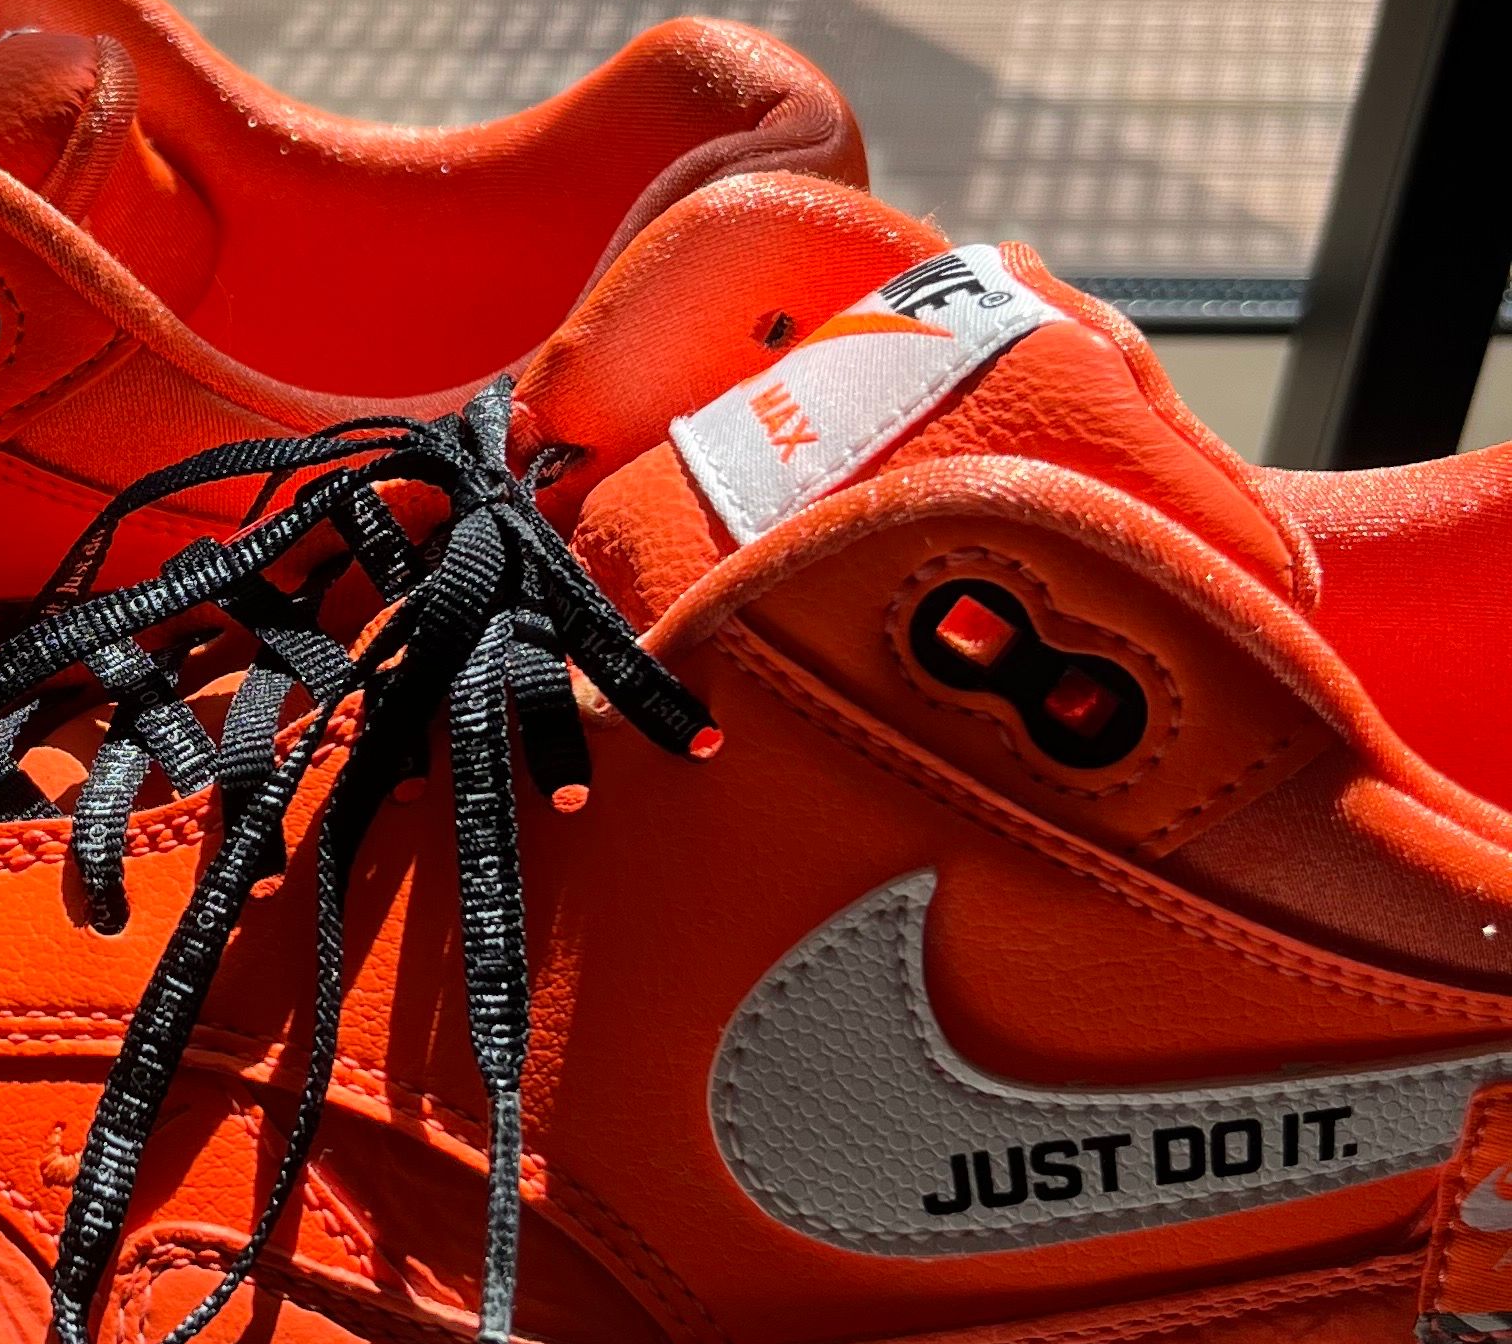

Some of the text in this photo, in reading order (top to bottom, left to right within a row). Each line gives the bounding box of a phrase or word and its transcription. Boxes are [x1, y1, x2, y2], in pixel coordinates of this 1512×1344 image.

[749, 383, 820, 464] MAX
[923, 1106, 1357, 1215] JUST DO IT.
